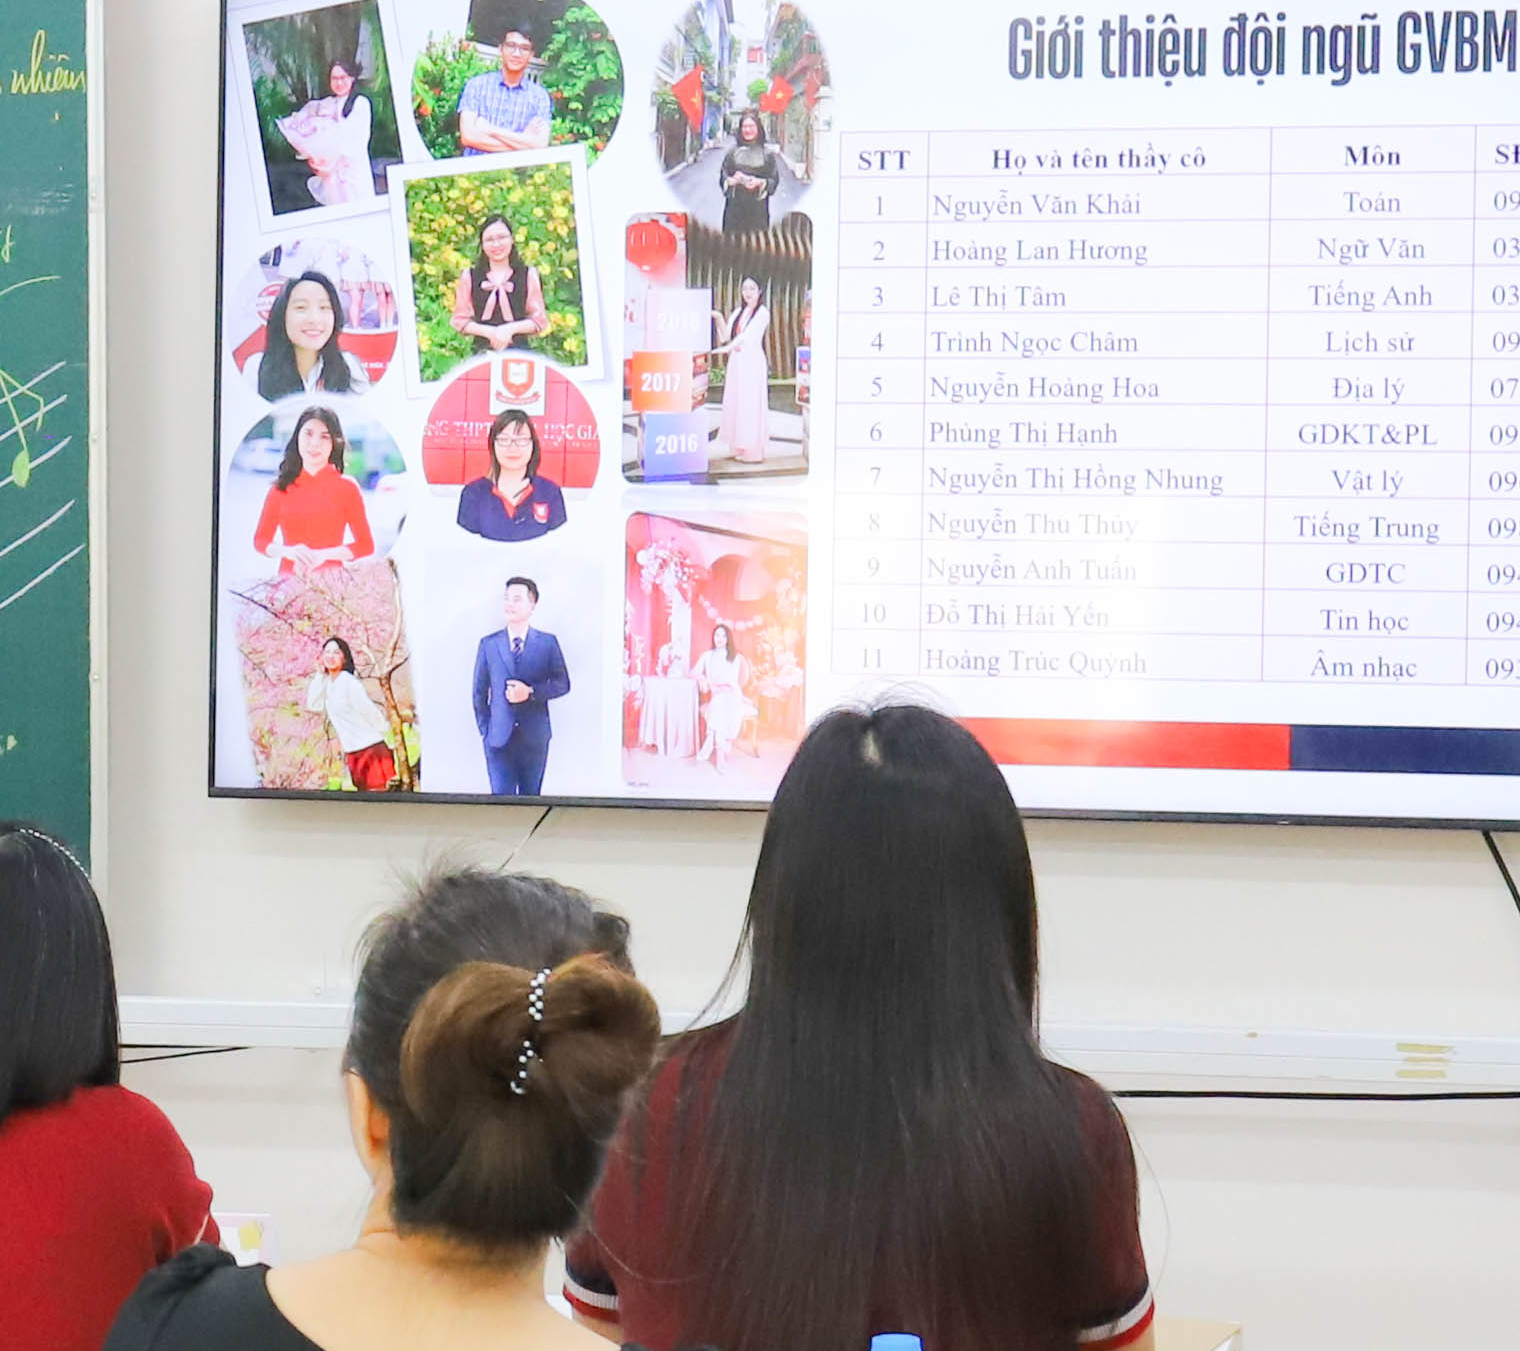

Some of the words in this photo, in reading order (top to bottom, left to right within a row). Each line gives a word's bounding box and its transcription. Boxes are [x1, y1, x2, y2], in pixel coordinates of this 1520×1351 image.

[1008, 16, 1084, 80] Giới
[1099, 14, 1207, 87] thiệu
[1223, 12, 1287, 86] đội
[1302, 13, 1381, 86] ngũ
[1397, 9, 1518, 74] GVBM
[858, 150, 911, 171] STT
[992, 149, 1027, 175] Họ
[1036, 150, 1062, 170] và
[1073, 149, 1107, 169] tên
[1118, 143, 1170, 174] thầy
[1180, 149, 1206, 168] cô
[1344, 146, 1401, 166] Môn
[876, 195, 884, 216] 1
[933, 190, 1023, 222] Nguyễn
[1032, 194, 1077, 215] Văn
[1343, 191, 1401, 213] Toán
[872, 241, 885, 261] 2
[933, 239, 1007, 267] Hoàng
[1017, 239, 1059, 261] Lan
[1069, 238, 1147, 267] Hương
[1317, 238, 1370, 265] Ngữ
[1377, 238, 1425, 259] Văn
[872, 286, 884, 307] 3
[933, 285, 961, 307] Lê
[969, 285, 1006, 310] Thị
[1015, 285, 1066, 307] Tâm
[1308, 280, 1375, 311] Tiếng
[1383, 285, 1432, 306] Anh
[871, 332, 884, 352] 4
[1001, 331, 1061, 359] Ngọc
[1071, 332, 1138, 352] Châm
[1326, 330, 1378, 356] Lịch
[1387, 330, 1415, 353] sử
[641, 373, 681, 393] 2017
[871, 378, 882, 397] 5
[930, 371, 1019, 403] Nguyễn
[1029, 377, 1103, 404] Hoàng
[1112, 377, 1159, 398] Hoa
[1332, 377, 1374, 402] Địa
[1384, 377, 1405, 405] lý
[655, 434, 698, 455] 2016
[870, 422, 883, 442] 6
[1009, 422, 1048, 446] Thị
[1056, 422, 1117, 446] Hạnh
[1298, 423, 1437, 446] GDKT&PL
[870, 467, 882, 487] 7
[928, 463, 1018, 494] Nguyễn
[1025, 468, 1064, 492] Thị
[1074, 463, 1136, 494] Hồng
[1145, 469, 1223, 495] Nhung
[1331, 469, 1374, 495] Vật
[1382, 469, 1404, 498] lý
[869, 512, 880, 531] 8
[928, 508, 1017, 539] Nguyễn
[1025, 513, 1070, 535] Thu
[1294, 510, 1360, 544] Tiếng
[1368, 517, 1440, 544] Trung
[867, 557, 879, 576] 9
[927, 553, 1015, 585] Nguyễn
[1024, 559, 1071, 580] Anh
[1080, 555, 1136, 581] Tuấn
[1325, 563, 1406, 584] GDTC
[863, 603, 886, 623] 10
[927, 599, 960, 626] Đỗ
[968, 604, 1005, 628] Thị
[1320, 610, 1359, 631] Tin
[1367, 610, 1409, 634] học
[863, 648, 882, 668] 11
[926, 649, 1000, 676] Hoàng
[1310, 650, 1353, 677] Âm
[1363, 657, 1417, 681] nhạc
